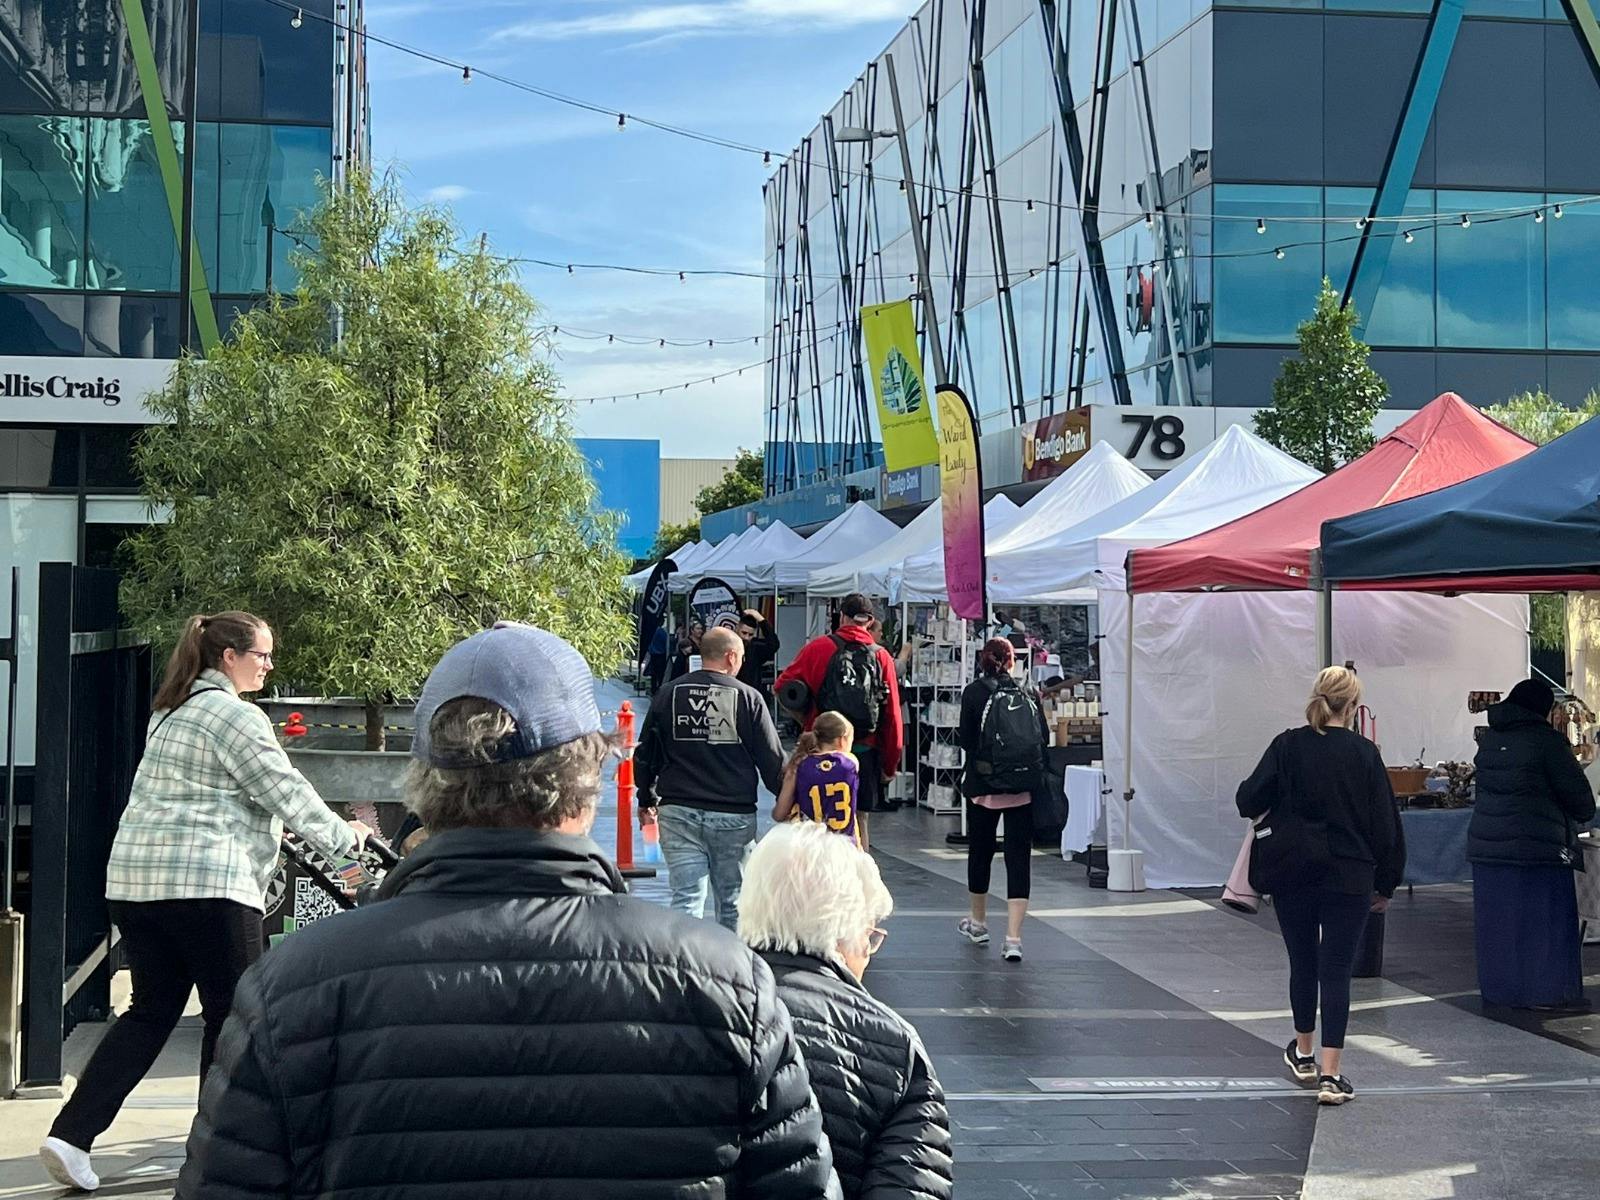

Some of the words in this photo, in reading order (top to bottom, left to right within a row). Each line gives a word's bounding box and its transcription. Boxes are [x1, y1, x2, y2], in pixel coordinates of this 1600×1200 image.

[1035, 432, 1064, 461] Bendigo
[1065, 426, 1087, 454] Bank
[1121, 414, 1186, 460] 78
[945, 448, 968, 485] Lady
[646, 572, 669, 614] UBX
[677, 715, 731, 728] RVCA
[808, 781, 852, 830] 13
